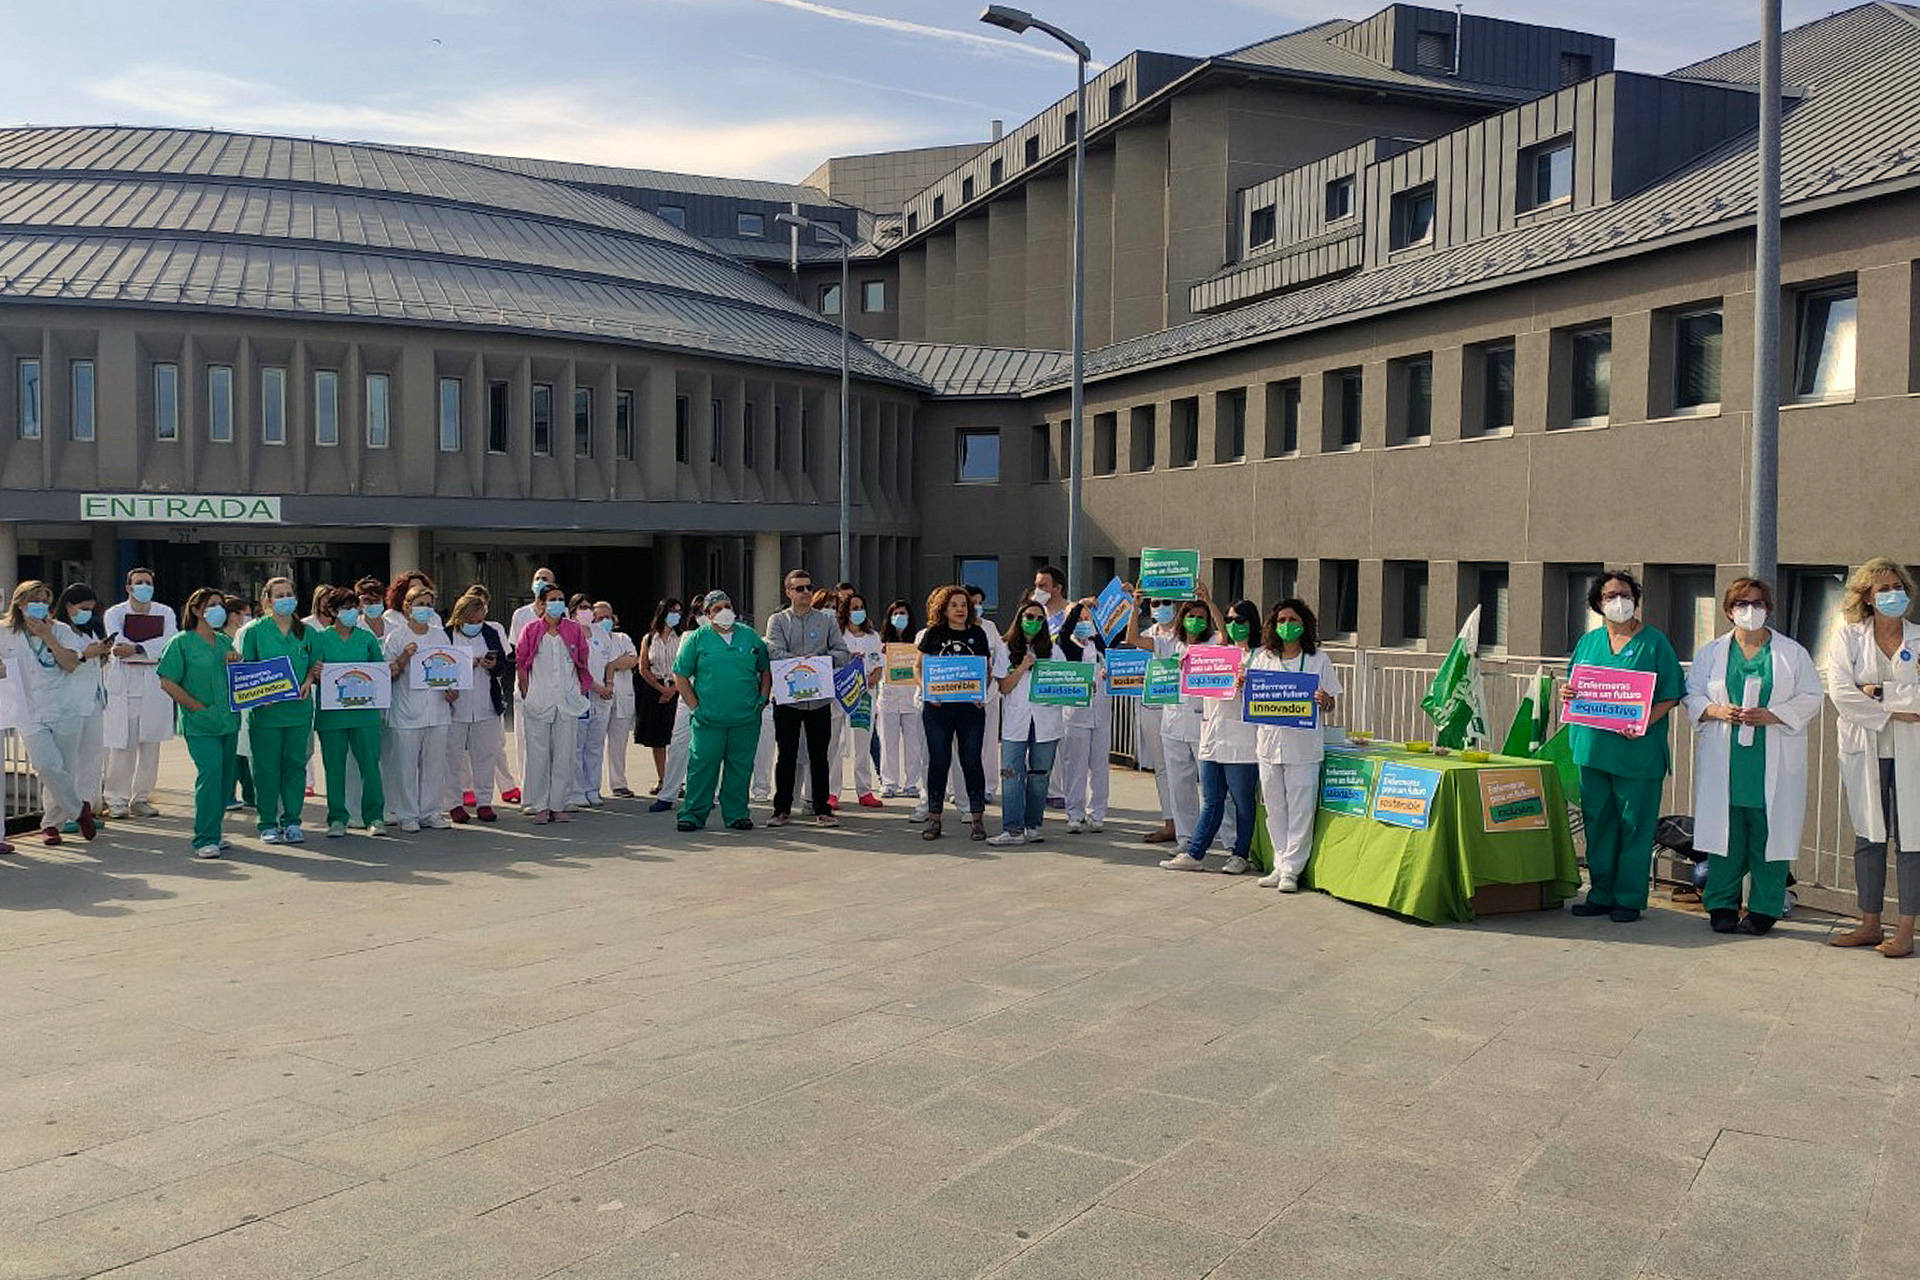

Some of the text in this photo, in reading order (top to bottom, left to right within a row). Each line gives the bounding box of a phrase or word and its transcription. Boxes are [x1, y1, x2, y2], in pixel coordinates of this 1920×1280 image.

[86, 498, 274, 518] ENTRADA
[221, 542, 323, 556] ENTRADA
[1251, 683, 1297, 691] Enfermeras
[1577, 681, 1631, 691] Enfermeras
[1252, 692, 1271, 700] para
[1283, 690, 1310, 698] futuro
[1576, 691, 1599, 699] para
[1613, 690, 1642, 699] futuro
[1253, 702, 1307, 714] innovador
[1575, 703, 1638, 717] equitativo
[1379, 799, 1420, 811] sostenible
